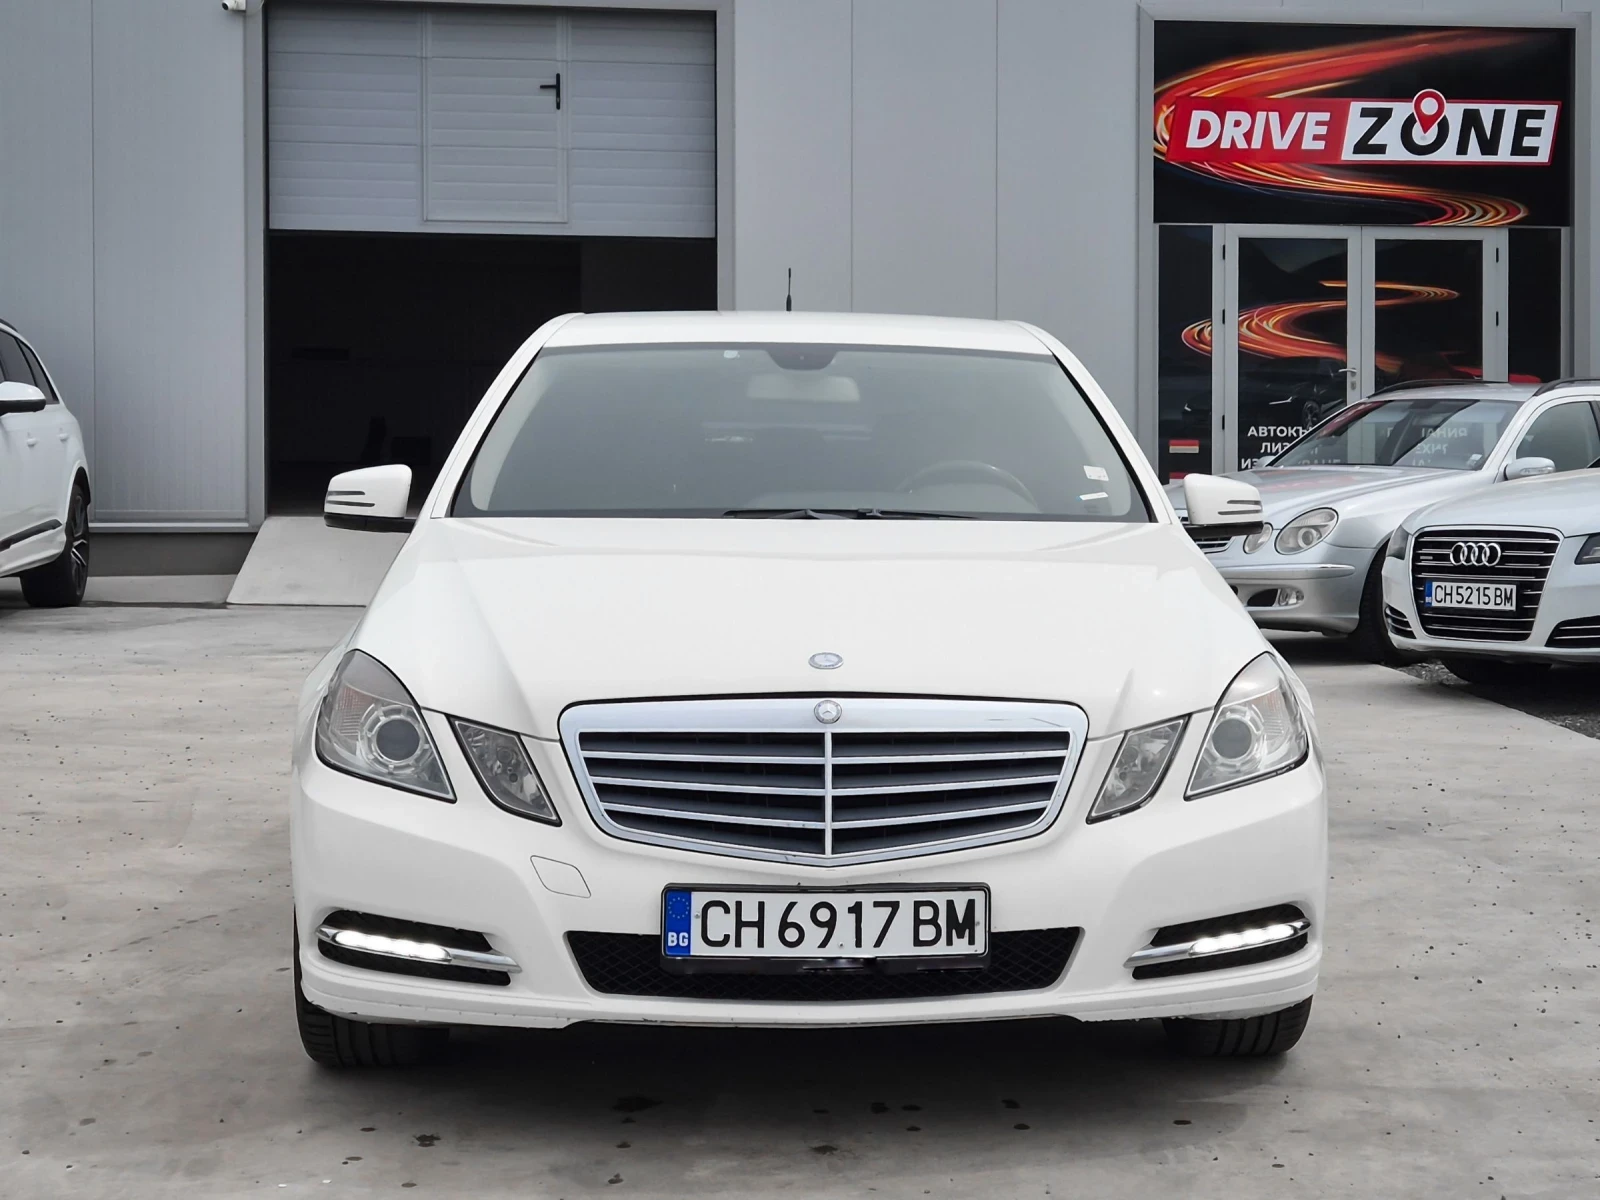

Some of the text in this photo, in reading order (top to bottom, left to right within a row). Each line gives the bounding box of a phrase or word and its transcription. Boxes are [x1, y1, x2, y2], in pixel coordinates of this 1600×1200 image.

[1186, 107, 1546, 157] DRIVE ZONE
[1247, 426, 1312, 437] АВТОКЪ
[1434, 585, 1513, 607] CH 5215 BM
[700, 898, 976, 949] CH 6917 BM
[667, 931, 689, 947] BG
